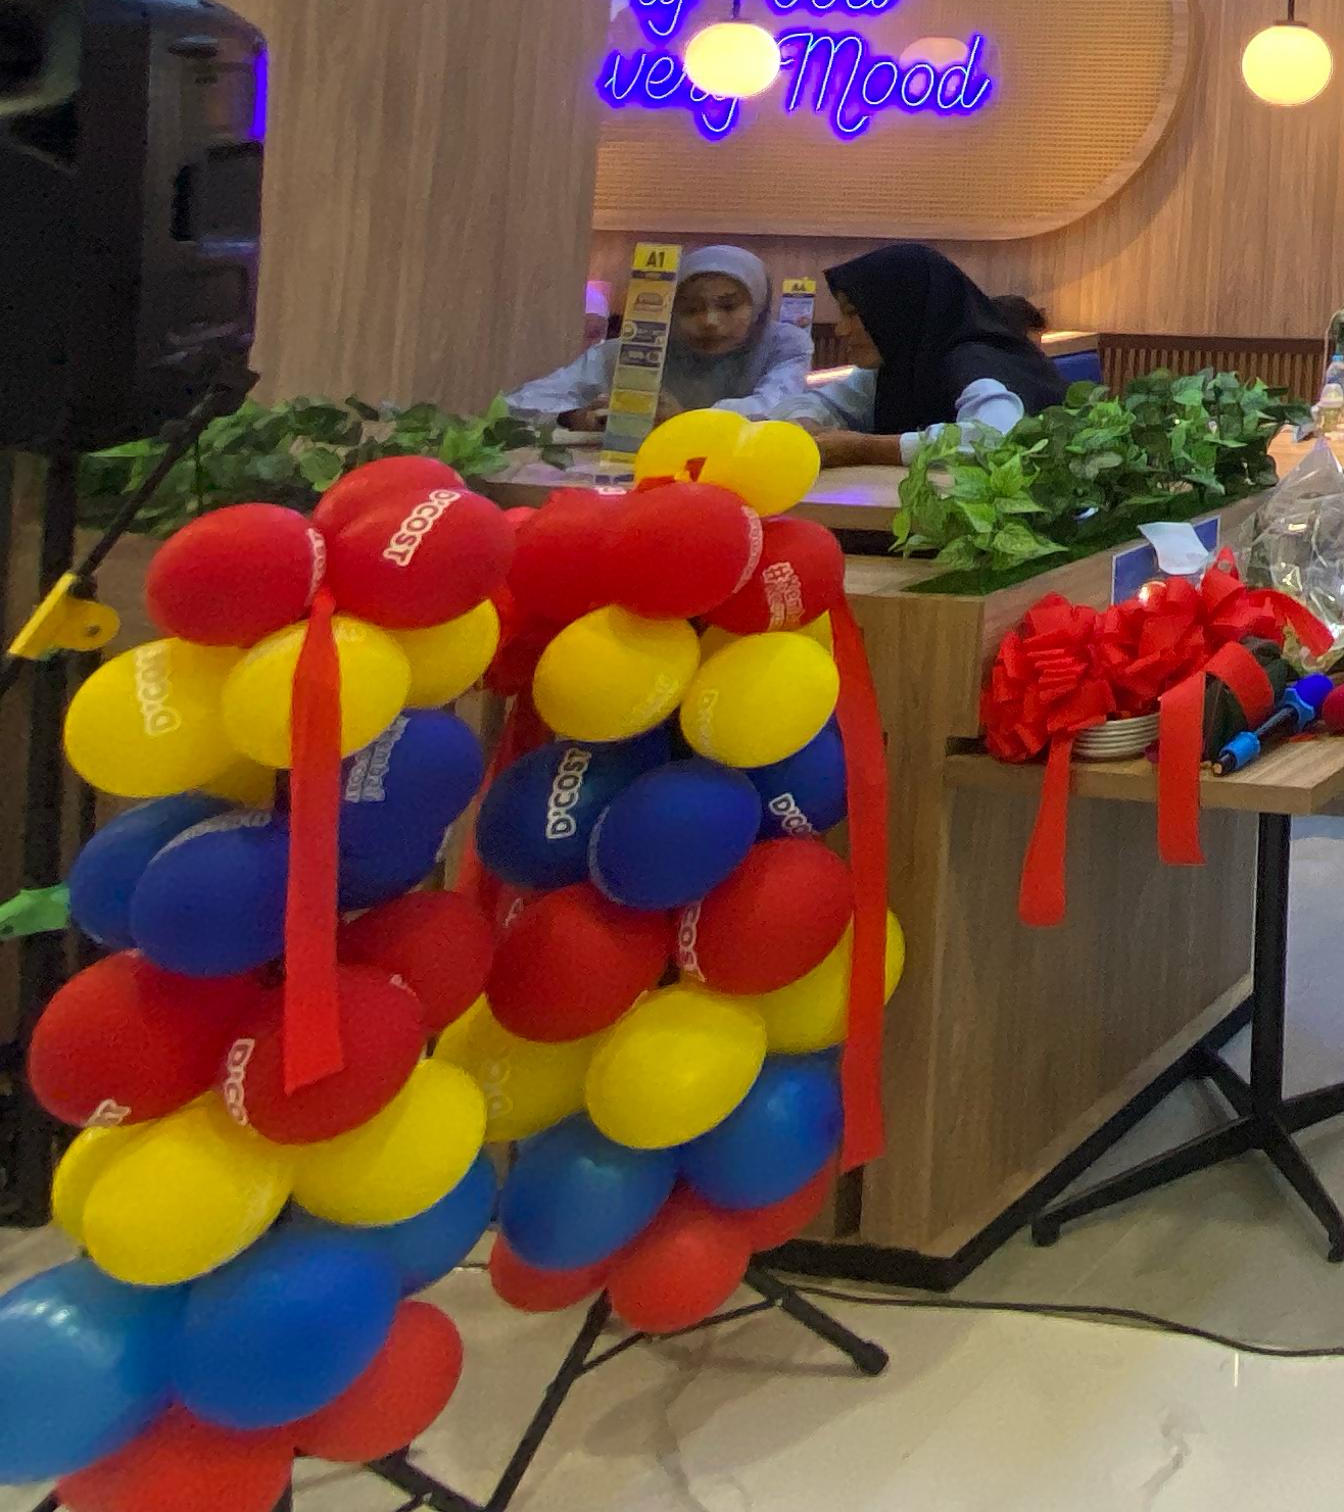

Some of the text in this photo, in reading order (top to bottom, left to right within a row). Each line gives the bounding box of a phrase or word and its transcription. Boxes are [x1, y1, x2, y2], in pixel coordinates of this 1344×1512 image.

[777, 32, 990, 133] Mood
[645, 251, 666, 268] A1
[382, 488, 461, 566] D'COST
[545, 747, 592, 840] D'COST
[223, 1037, 256, 1127] D'CO
